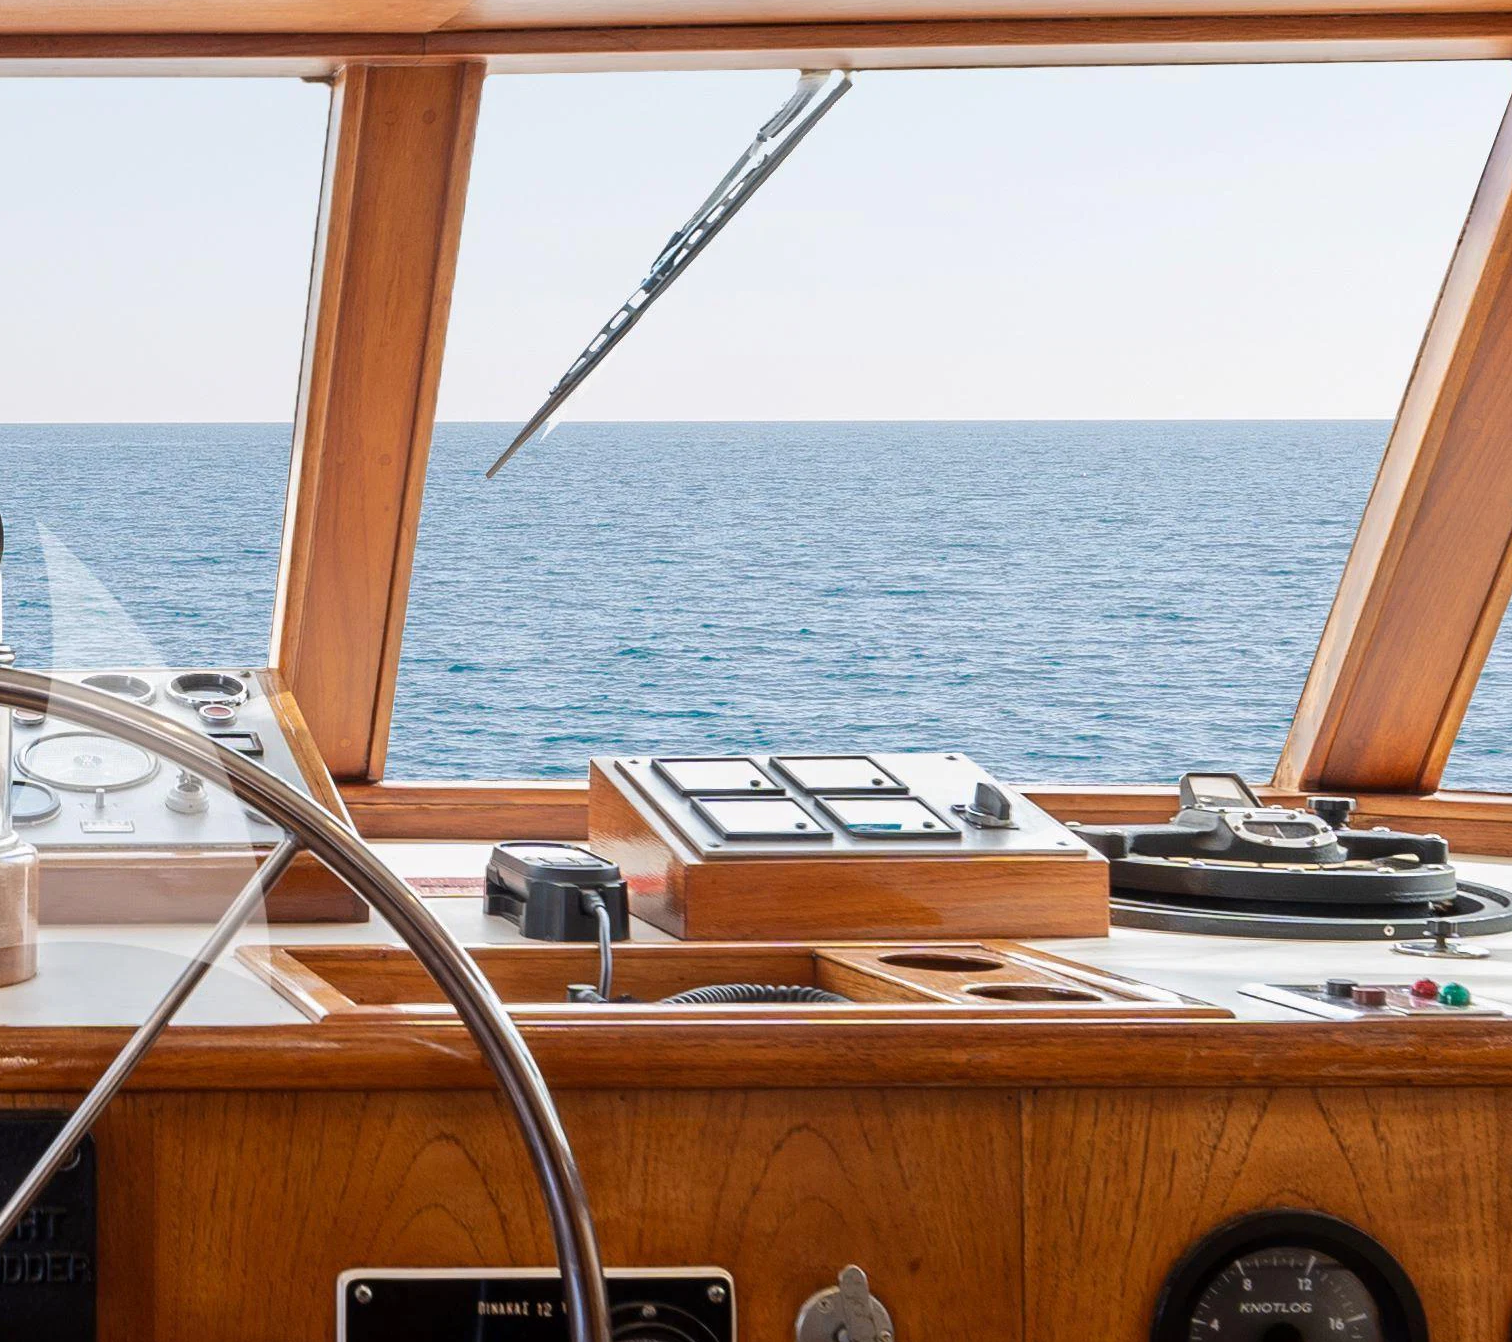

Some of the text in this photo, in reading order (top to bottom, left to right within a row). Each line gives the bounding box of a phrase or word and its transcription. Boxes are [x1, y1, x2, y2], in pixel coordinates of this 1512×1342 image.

[1242, 1278, 1253, 1291] 8
[1297, 1277, 1313, 1291] 12
[477, 1300, 553, 1317] ΠΙΝΑΚΑΣ 12
[1238, 1302, 1313, 1314] KNOTLOG
[1209, 1318, 1221, 1331] 4
[1328, 1317, 1345, 1331] 16
